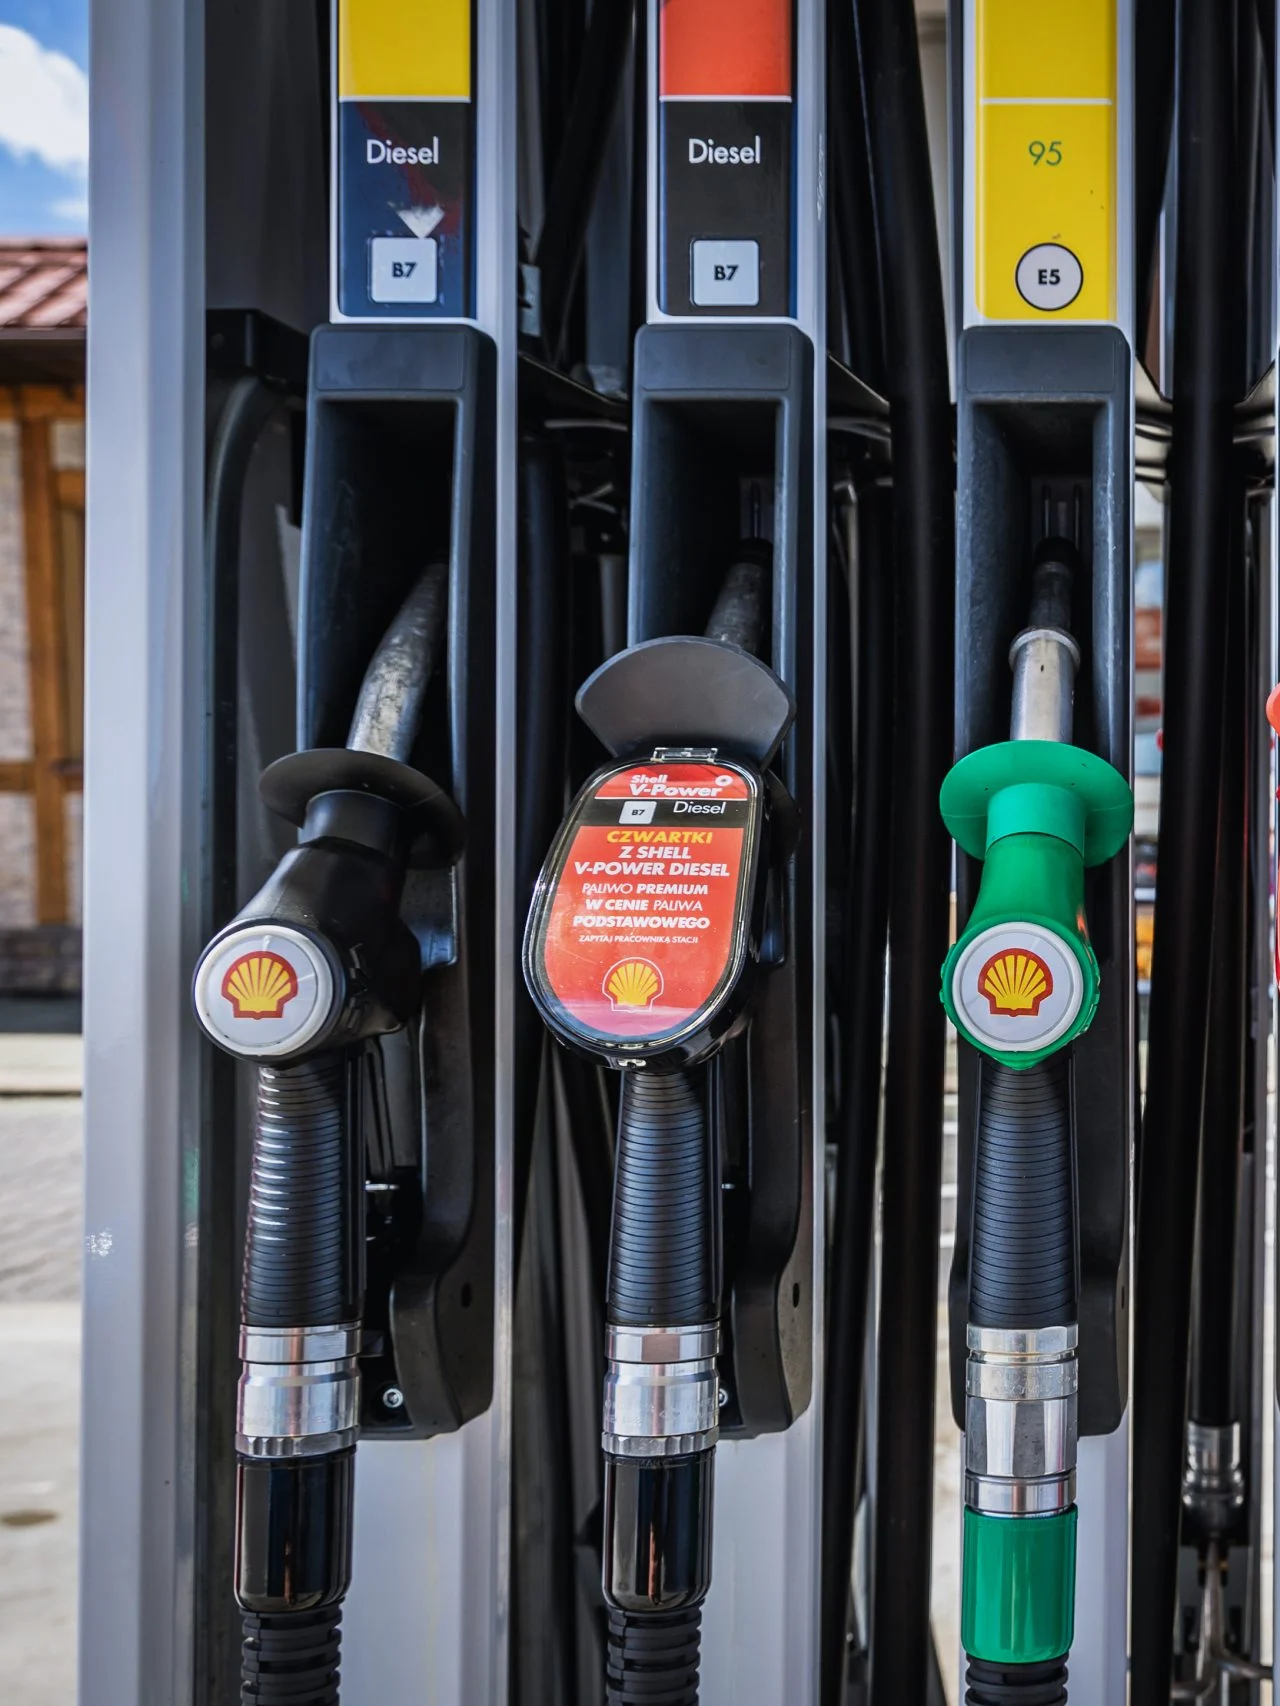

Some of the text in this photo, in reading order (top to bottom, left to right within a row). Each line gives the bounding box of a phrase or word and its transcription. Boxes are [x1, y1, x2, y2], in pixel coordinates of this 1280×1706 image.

[367, 136, 438, 165] Diesel
[689, 136, 761, 164] Diesel
[1028, 141, 1062, 167] 95
[392, 262, 416, 279] B7
[715, 264, 738, 281] B7
[1038, 269, 1060, 286] E5
[630, 775, 667, 785] Shell
[630, 784, 722, 797] V-Power
[673, 801, 726, 815] Diesel
[607, 831, 712, 844] CZWARTKI
[619, 846, 692, 859] Z SHELL
[575, 862, 730, 877] V-POWER DIESEL
[582, 883, 708, 895] PALIWO PREMIUM
[586, 899, 703, 911] W CENIE PALIWA
[573, 916, 710, 929] PODSTAWOWEGO
[579, 935, 613, 944] ZAPYTAJ
[672, 936, 699, 944] STACJI
